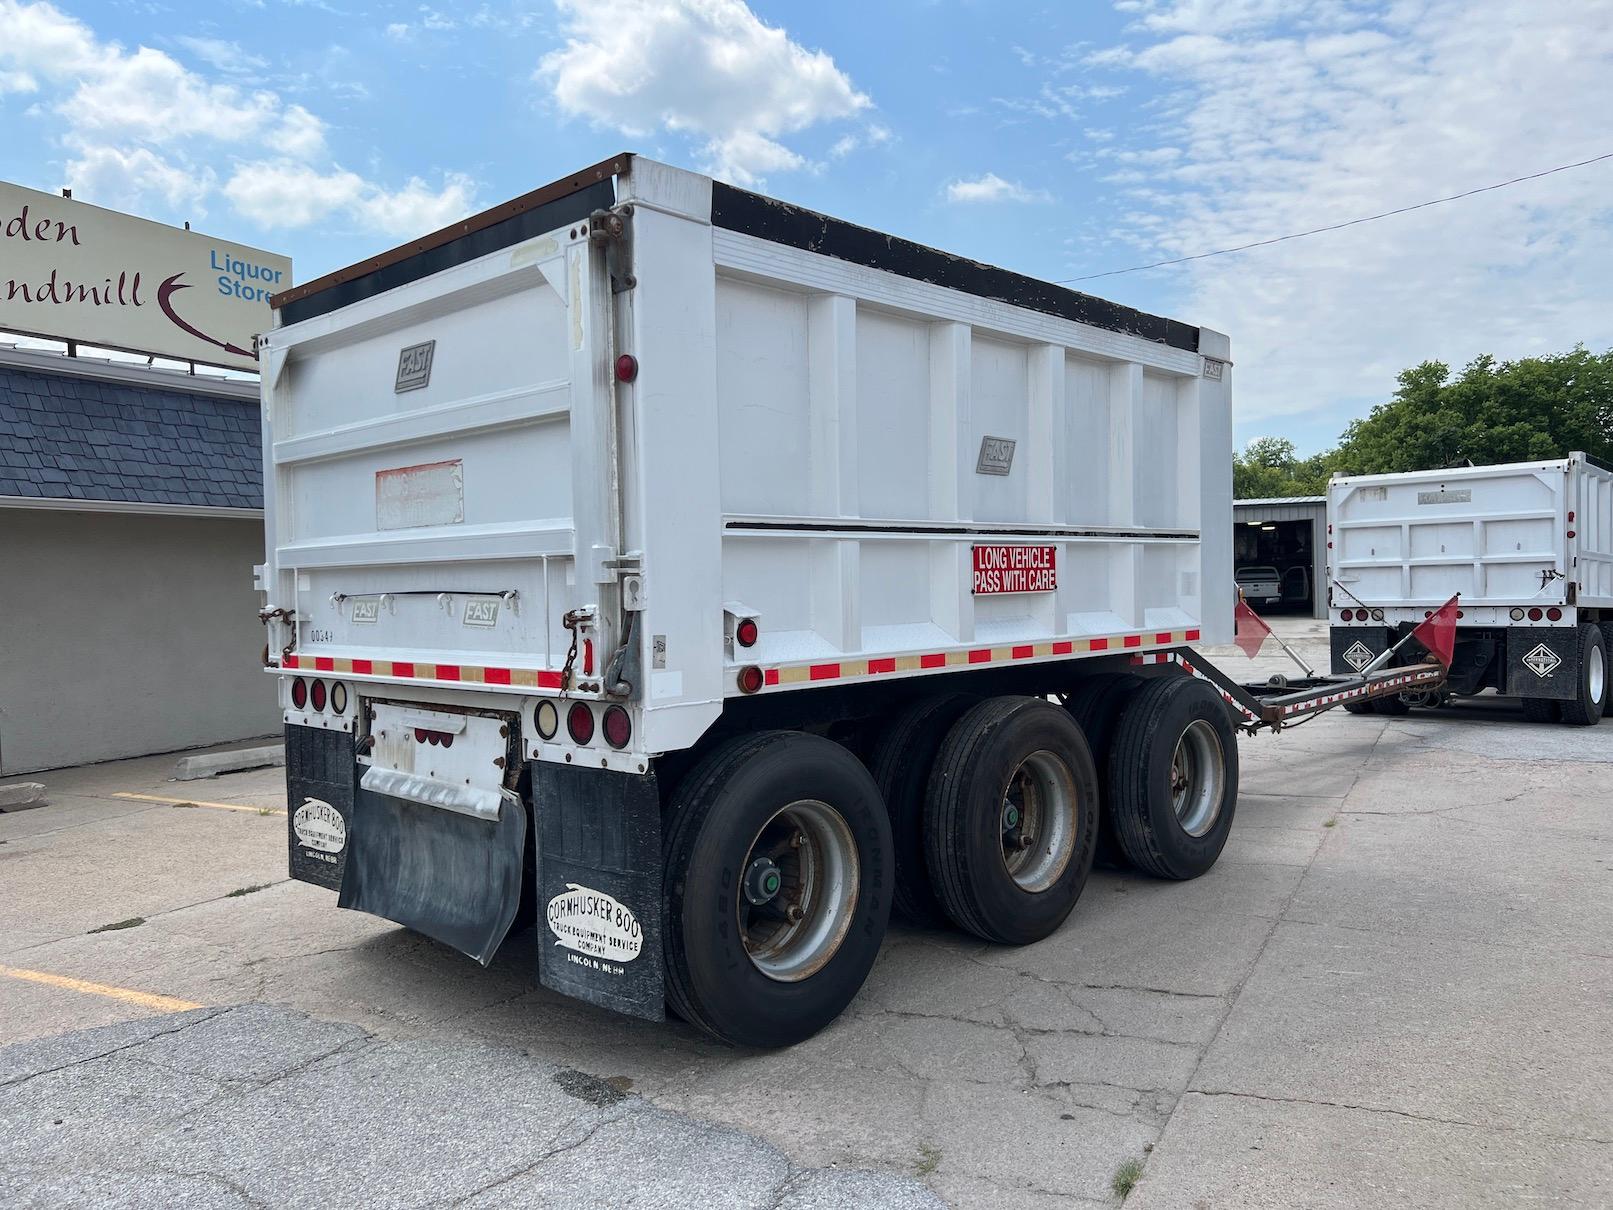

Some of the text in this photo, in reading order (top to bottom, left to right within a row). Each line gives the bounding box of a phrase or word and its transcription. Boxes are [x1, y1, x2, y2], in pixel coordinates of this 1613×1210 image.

[0, 206, 80, 246] den
[211, 250, 282, 284] Liquor
[0, 269, 146, 307] ndmill
[399, 346, 432, 384] EAST
[978, 547, 1050, 569] LONG VEHICLE
[974, 569, 1055, 592] PASS WITH CARE
[353, 600, 377, 623] EAST
[464, 601, 496, 626] EAST
[548, 896, 639, 938] CORNHUSKER 800
[553, 921, 638, 952] TRUCK EQUIPMENT SERVICE
[577, 940, 606, 955] COMPANY
